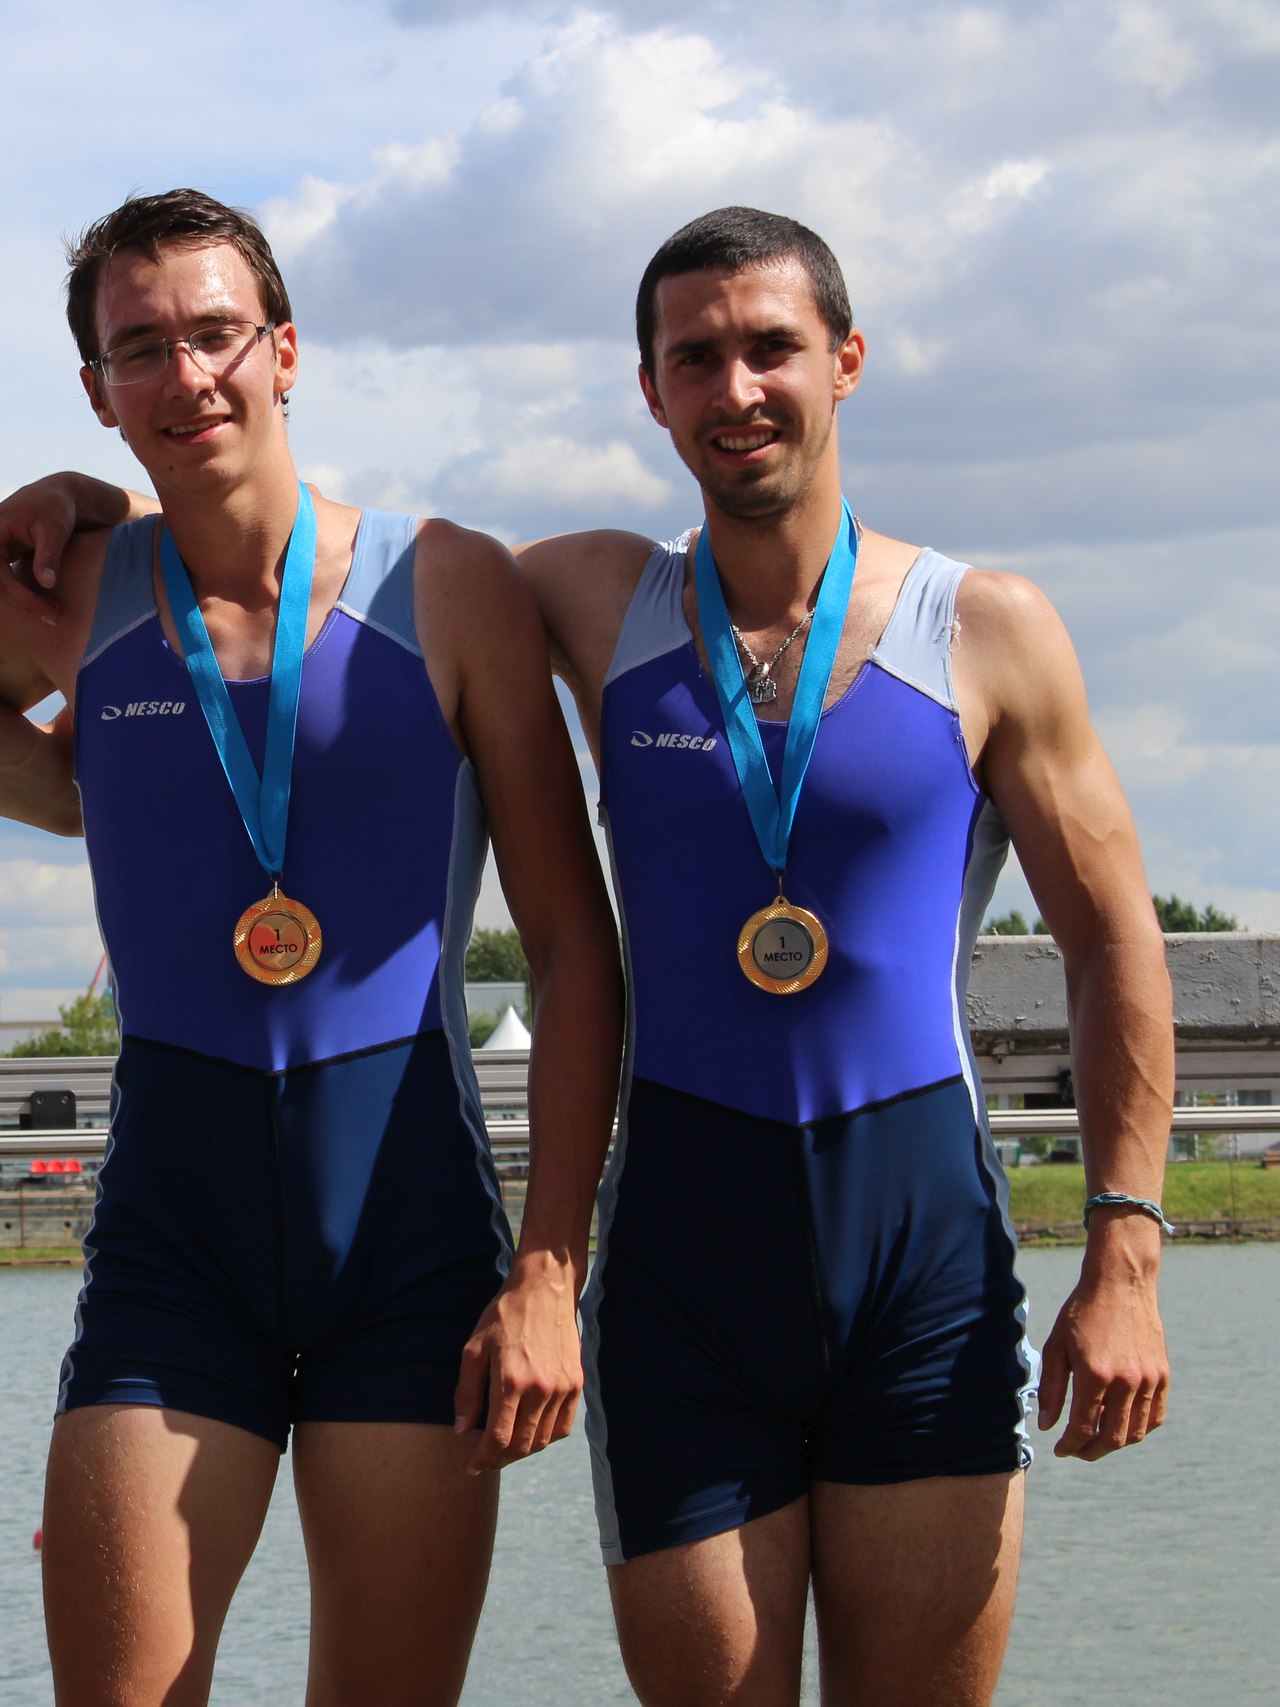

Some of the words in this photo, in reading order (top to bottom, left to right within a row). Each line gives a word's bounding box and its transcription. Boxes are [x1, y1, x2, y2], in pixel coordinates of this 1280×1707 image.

[124, 701, 186, 717] NESCO
[655, 733, 717, 752] NESCO
[274, 928, 280, 942] 1
[259, 943, 298, 955] МЕСТО
[779, 936, 785, 949] 1
[763, 951, 803, 962] МЕСТО
